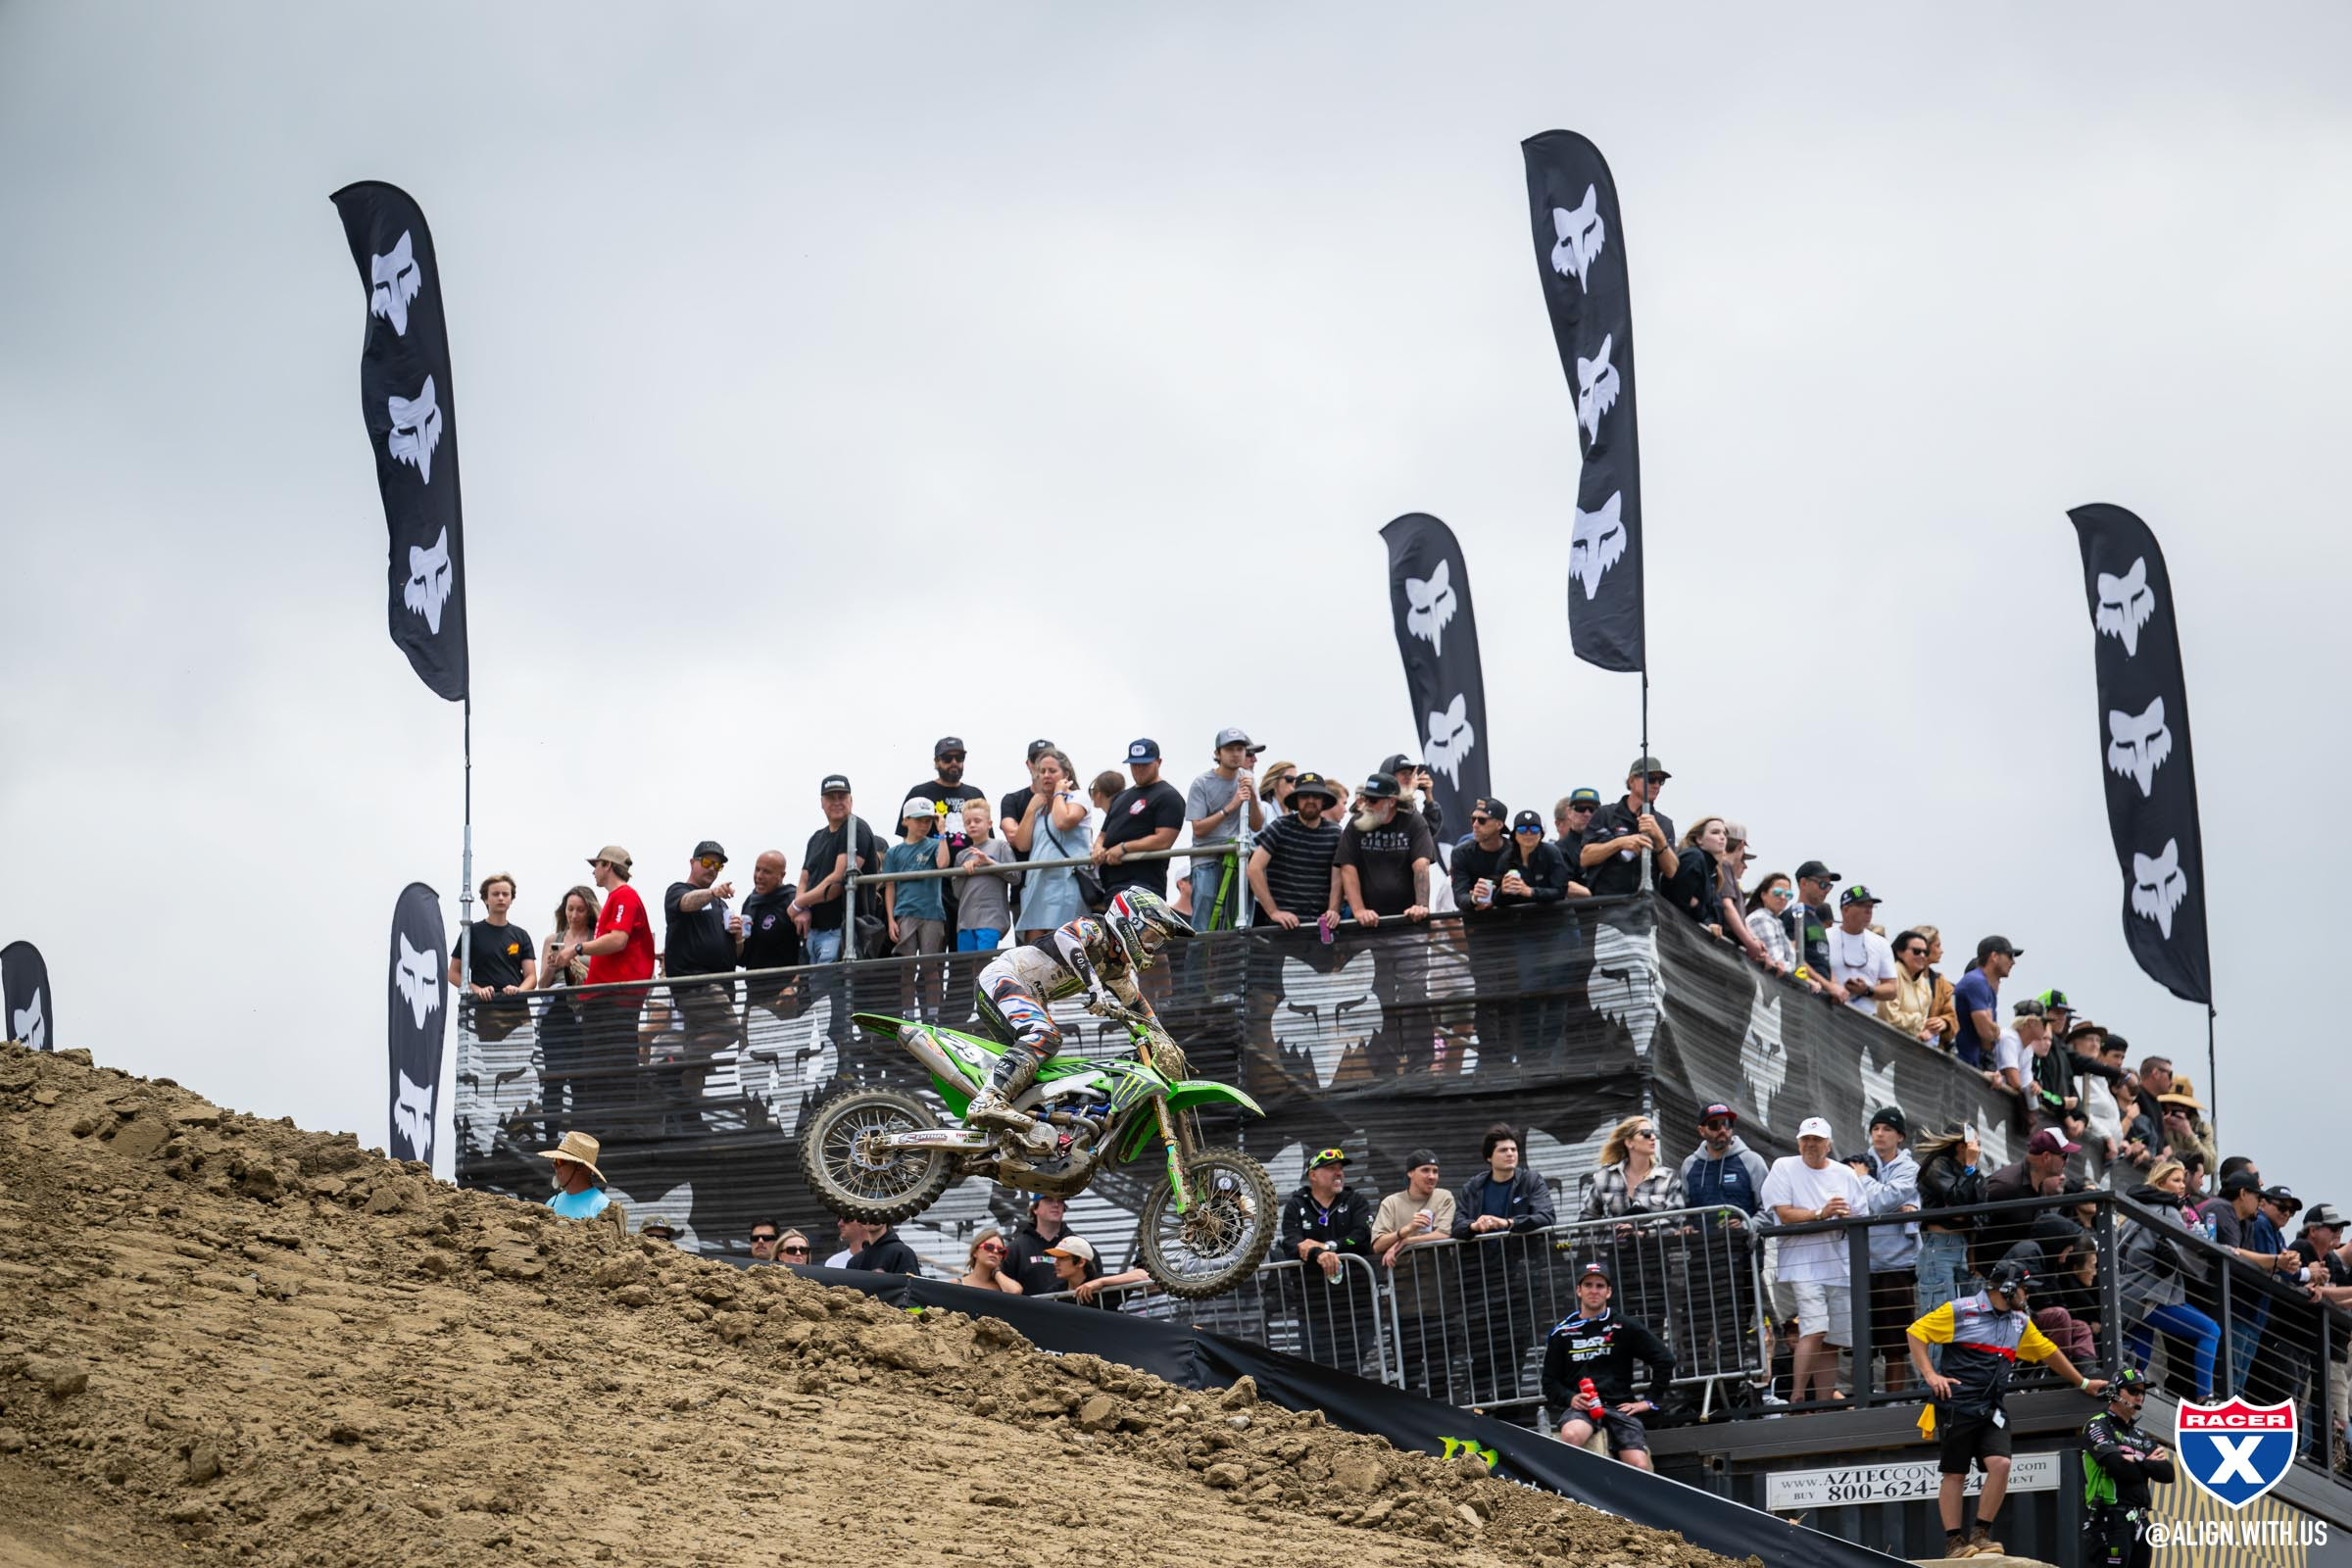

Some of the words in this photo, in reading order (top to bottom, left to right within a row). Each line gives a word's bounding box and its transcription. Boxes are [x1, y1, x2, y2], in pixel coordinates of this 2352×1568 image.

[1074, 952, 1086, 970] FOX
[938, 1036, 985, 1064] 29
[1793, 1491, 1815, 1500] BUY
